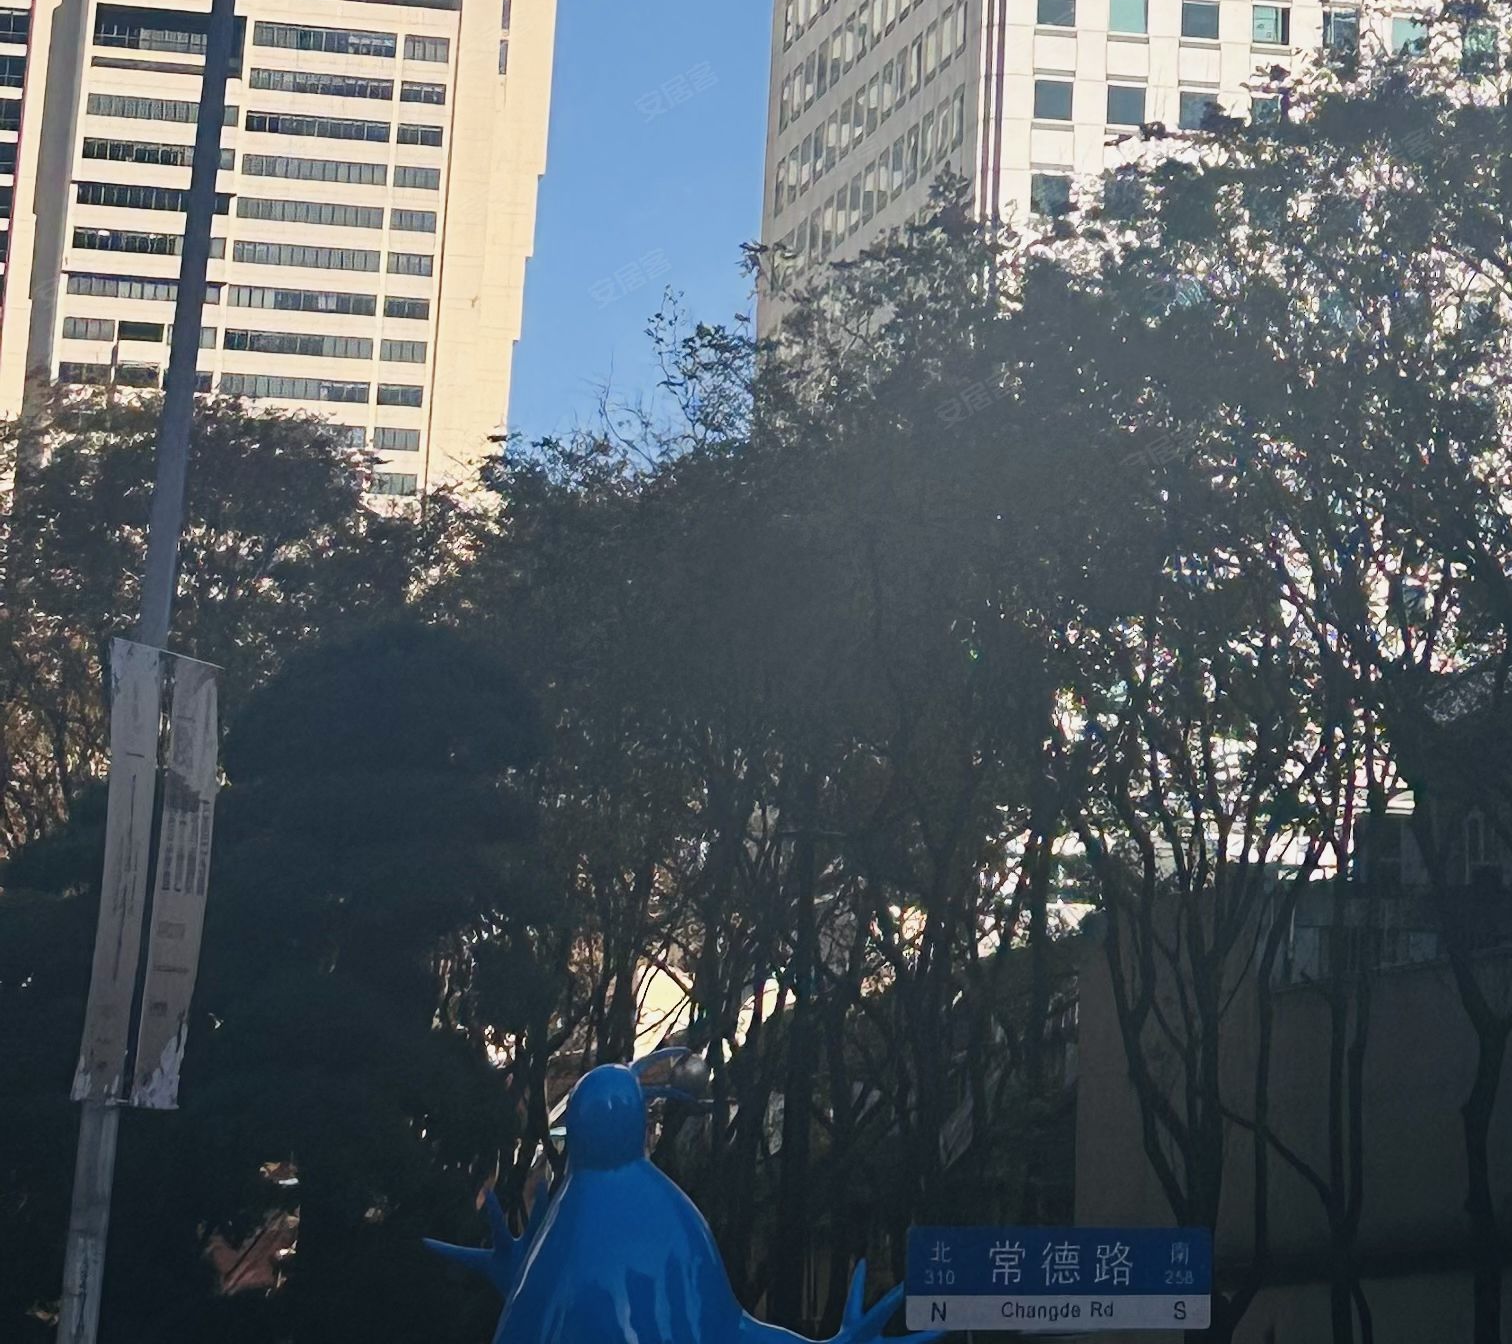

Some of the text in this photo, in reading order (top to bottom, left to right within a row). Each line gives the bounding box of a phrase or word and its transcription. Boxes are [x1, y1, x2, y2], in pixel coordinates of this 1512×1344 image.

[930, 1240, 952, 1263] 北
[989, 1240, 1134, 1287] 常德路
[924, 1270, 955, 1286] 310
[931, 1303, 947, 1322] N
[1001, 1301, 1114, 1321] Changde Rd
[1174, 1301, 1186, 1320] S
